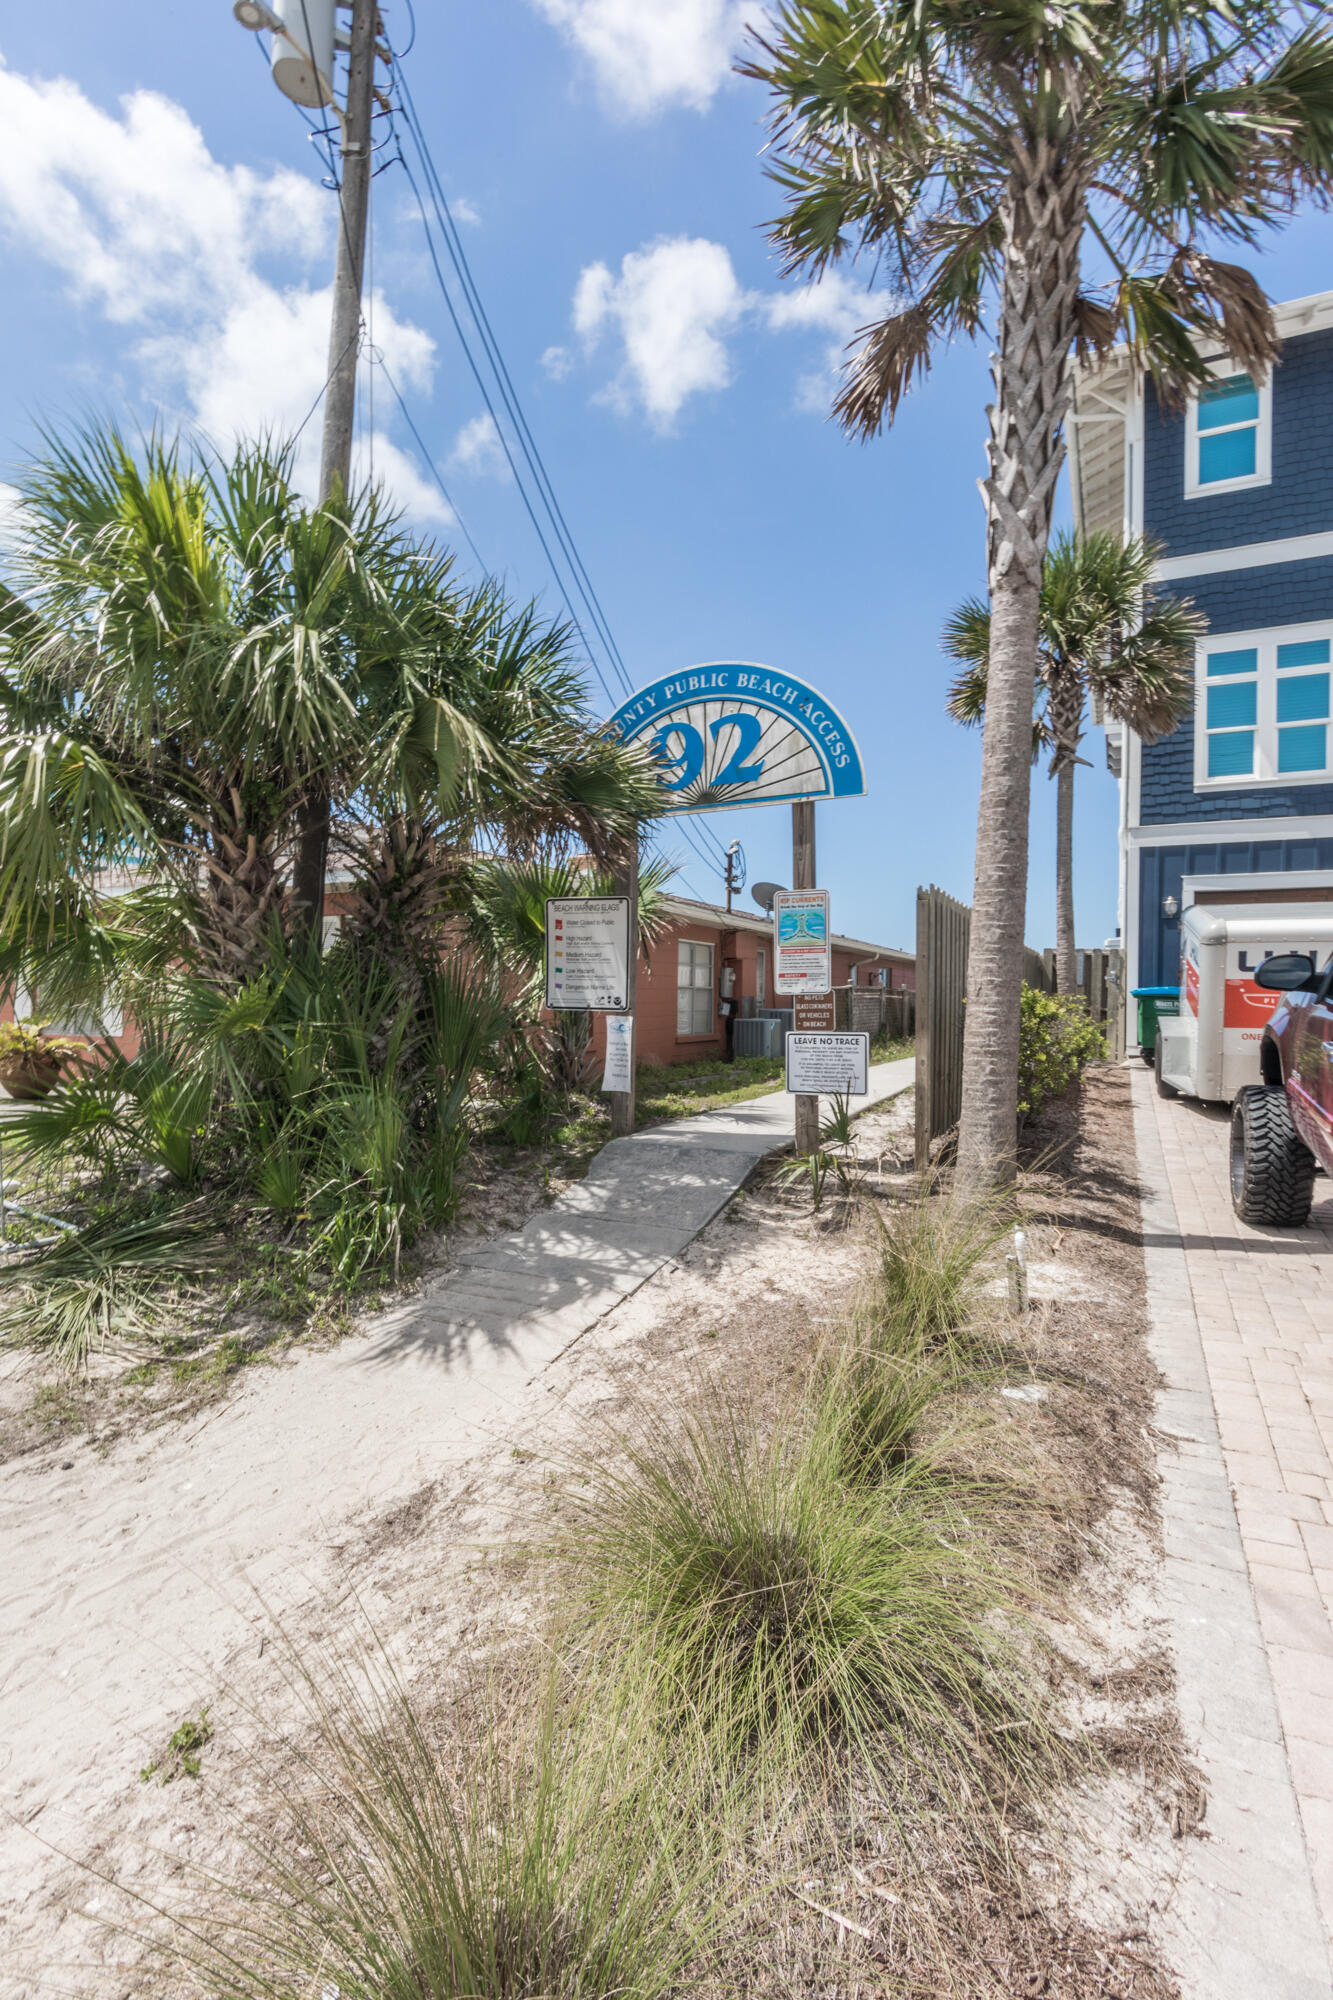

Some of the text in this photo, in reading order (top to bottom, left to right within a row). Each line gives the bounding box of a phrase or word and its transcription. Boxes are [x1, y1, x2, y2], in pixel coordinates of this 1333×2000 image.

[664, 673, 729, 699] PUBLIC
[736, 673, 799, 704] BEACH
[800, 701, 850, 768] ACCESS
[647, 712, 766, 791] 92
[553, 904, 574, 912] BEACH
[574, 904, 601, 912] WARNING
[794, 1037, 860, 1046] LEAVE NO TRACE
